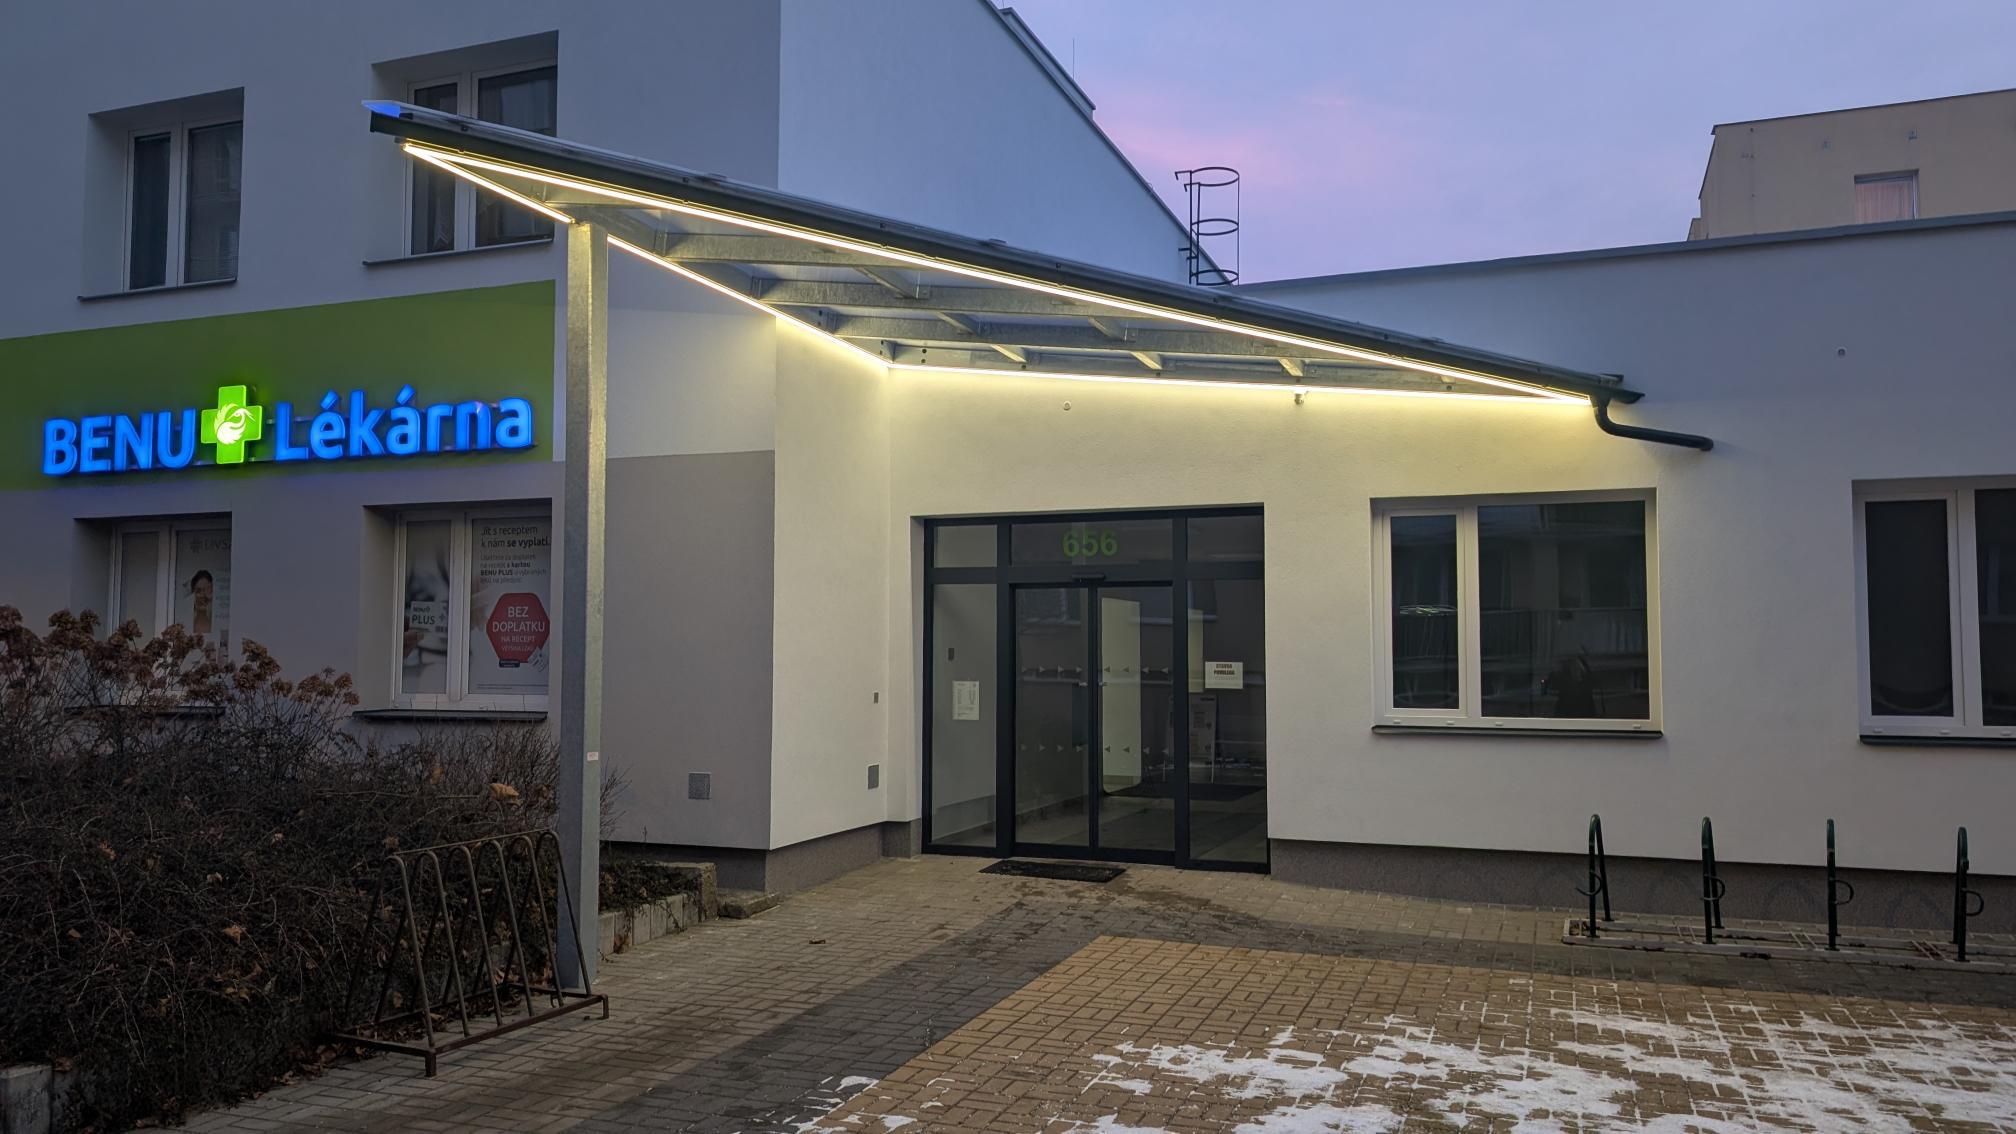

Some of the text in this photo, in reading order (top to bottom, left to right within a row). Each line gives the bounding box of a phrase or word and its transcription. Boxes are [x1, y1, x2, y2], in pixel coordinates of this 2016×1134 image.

[43, 385, 535, 476] BENU Lékárna
[499, 526, 538, 536] receptem
[487, 538, 505, 548] nám
[507, 539, 517, 547] se
[1062, 529, 1118, 557] 656
[507, 606, 529, 618] BEZ
[411, 614, 436, 625] PLUS
[492, 620, 545, 633] DOPLATKU
